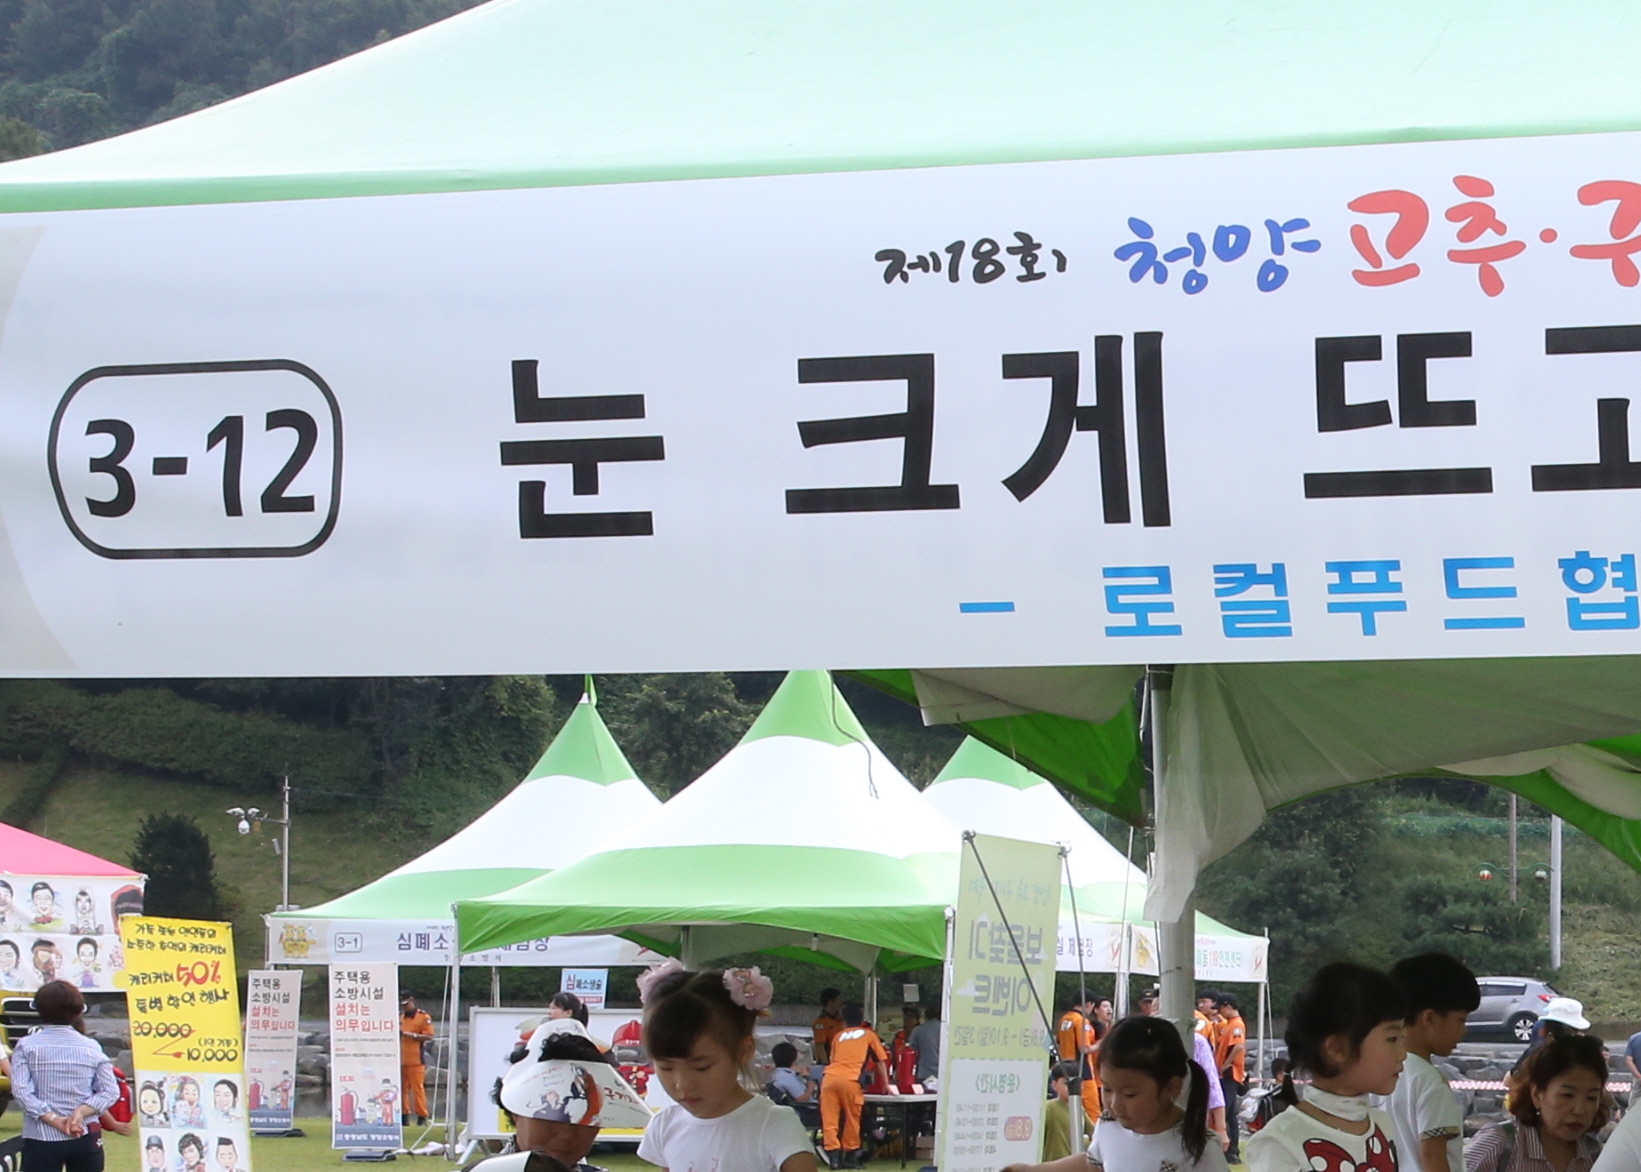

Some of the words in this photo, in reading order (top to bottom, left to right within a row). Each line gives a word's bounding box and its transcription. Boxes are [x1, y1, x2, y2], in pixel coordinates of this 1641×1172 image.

[876, 232, 1067, 283] 제18회
[1114, 217, 1321, 294] 청양
[500, 359, 665, 538] 눈
[786, 332, 1171, 527] 크게
[87, 409, 318, 517] 3-12
[337, 936, 360, 950] 3-1
[176, 960, 222, 987] 50%
[333, 970, 371, 984] 주택용
[252, 978, 281, 990] 주택용
[252, 991, 291, 1004] 소방시설
[334, 986, 384, 1000] 소방시설
[252, 1006, 279, 1017] 설치는
[335, 1003, 371, 1017] 설치는
[251, 1020, 295, 1031] 의무입니다
[335, 1018, 394, 1032] 의무입니다
